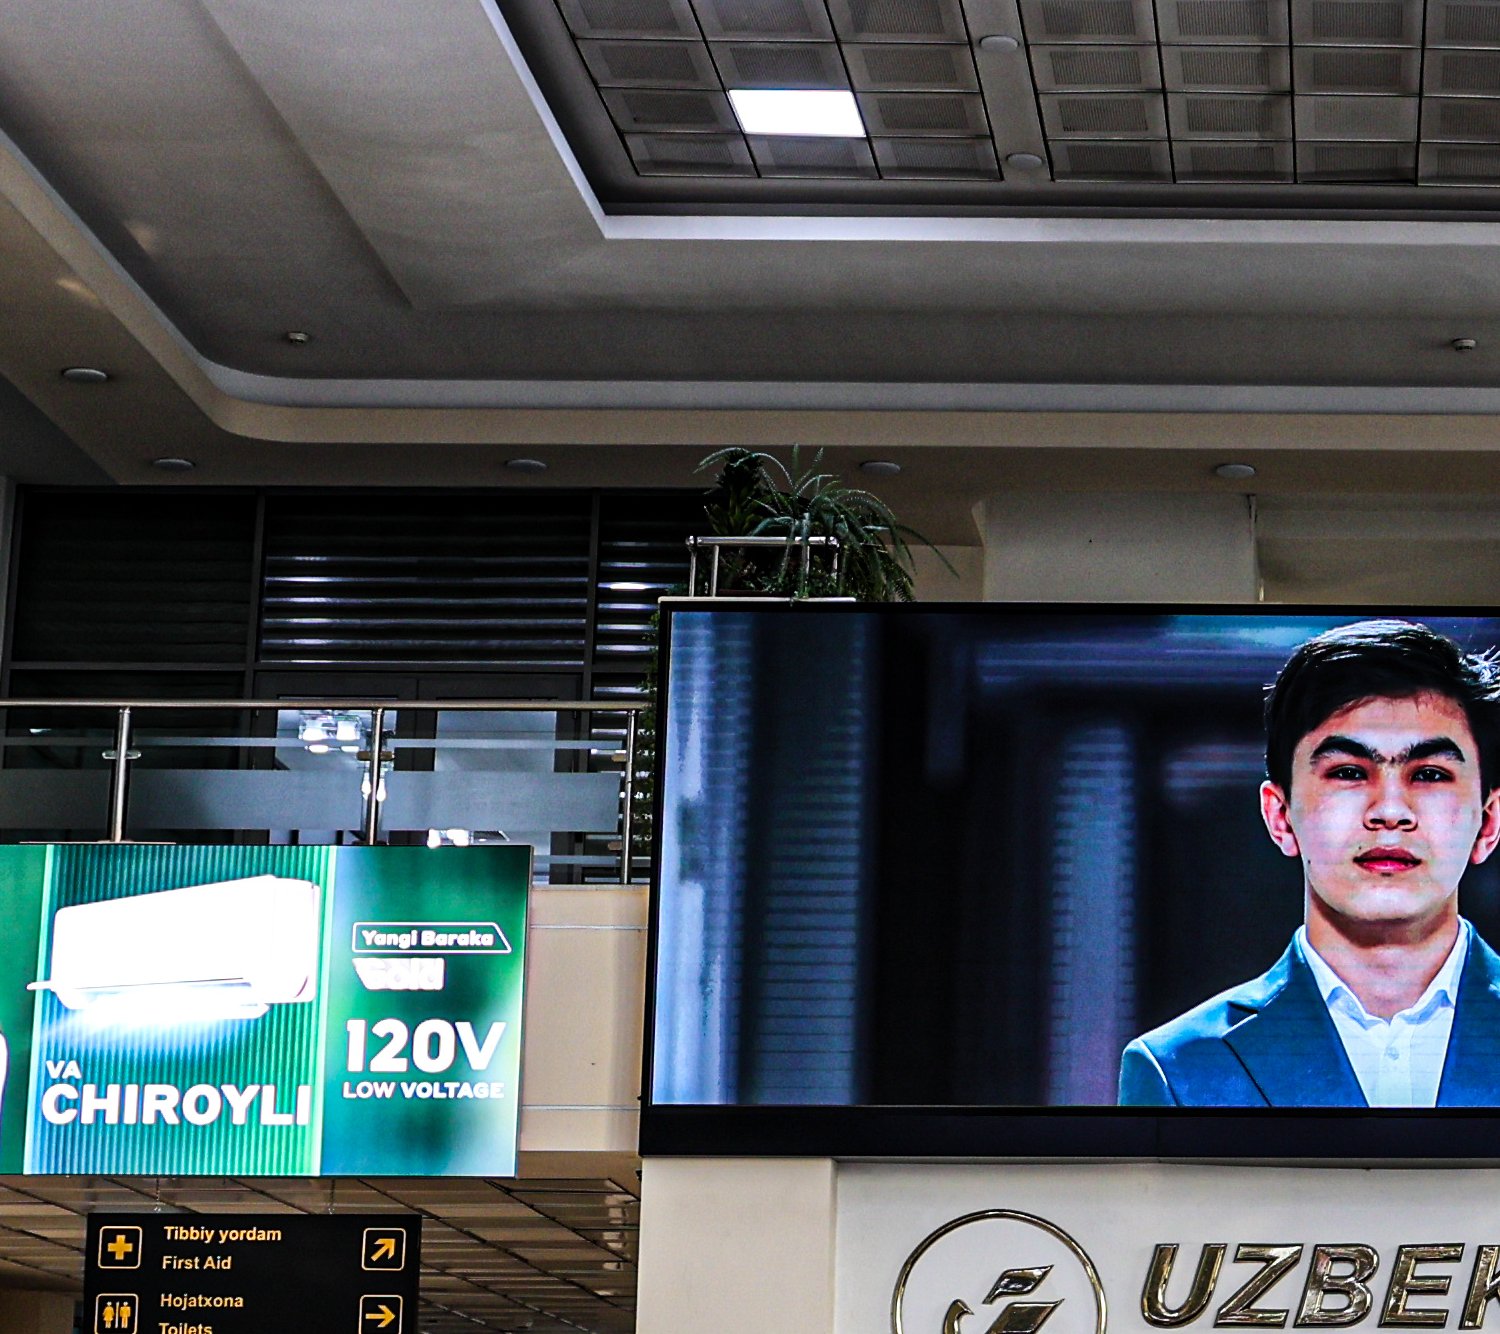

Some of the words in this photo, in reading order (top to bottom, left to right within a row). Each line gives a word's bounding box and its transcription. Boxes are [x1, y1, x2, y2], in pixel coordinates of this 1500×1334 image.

[361, 929, 418, 949] Yangi
[420, 929, 494, 946] Baraka
[346, 1018, 507, 1074] 120V
[45, 1060, 82, 1080] VA
[342, 1081, 396, 1099] LOW
[400, 1081, 505, 1099] VOLTAGE
[41, 1082, 311, 1127] CHIROYLI
[163, 1226, 215, 1244] Tibbiy
[219, 1226, 282, 1244] yordam
[162, 1255, 200, 1270] First
[203, 1255, 232, 1270] Aid
[159, 1293, 244, 1311] Hojatxona
